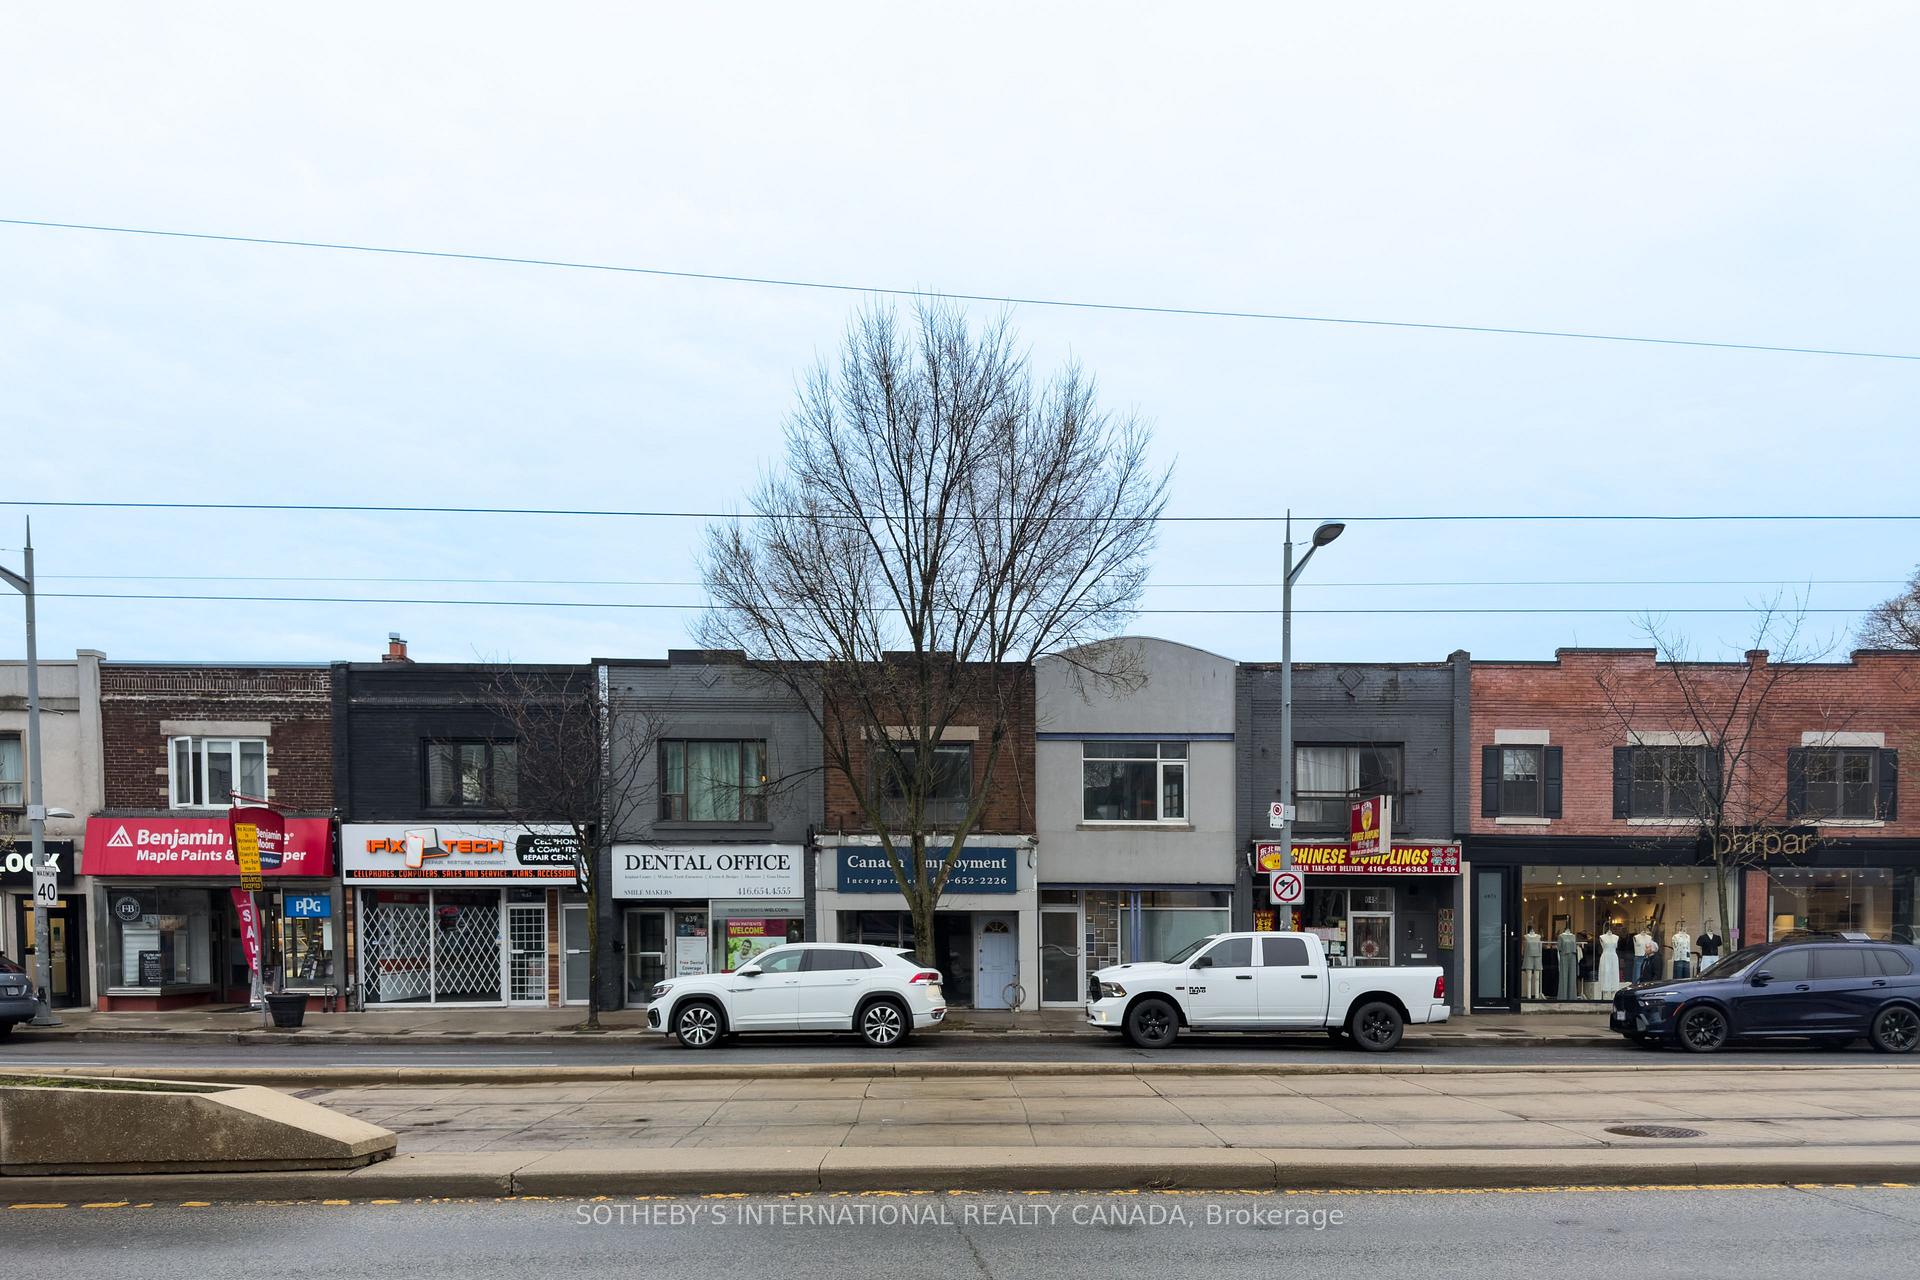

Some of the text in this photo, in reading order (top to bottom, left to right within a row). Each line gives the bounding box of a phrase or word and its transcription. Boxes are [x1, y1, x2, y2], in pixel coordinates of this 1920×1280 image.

[137, 829, 223, 849] Benjamin
[443, 839, 503, 853] TECH
[0, 853, 61, 873] OK
[137, 850, 236, 863] Maple Paints &
[625, 854, 791, 871] DENTAL OFFICE
[925, 855, 1008, 872] mpoyment
[1291, 848, 1347, 865] CHINESE
[353, 870, 397, 878] CELLPHONES,
[442, 870, 463, 878] SALES
[465, 870, 479, 878] AND
[931, 877, 1008, 885] 4-652-2226
[38, 883, 56, 901] 40
[737, 887, 792, 896] 416.654.4555
[296, 898, 321, 915] PPG
[730, 926, 765, 935] WELCOME
[242, 909, 260, 971] SALE
